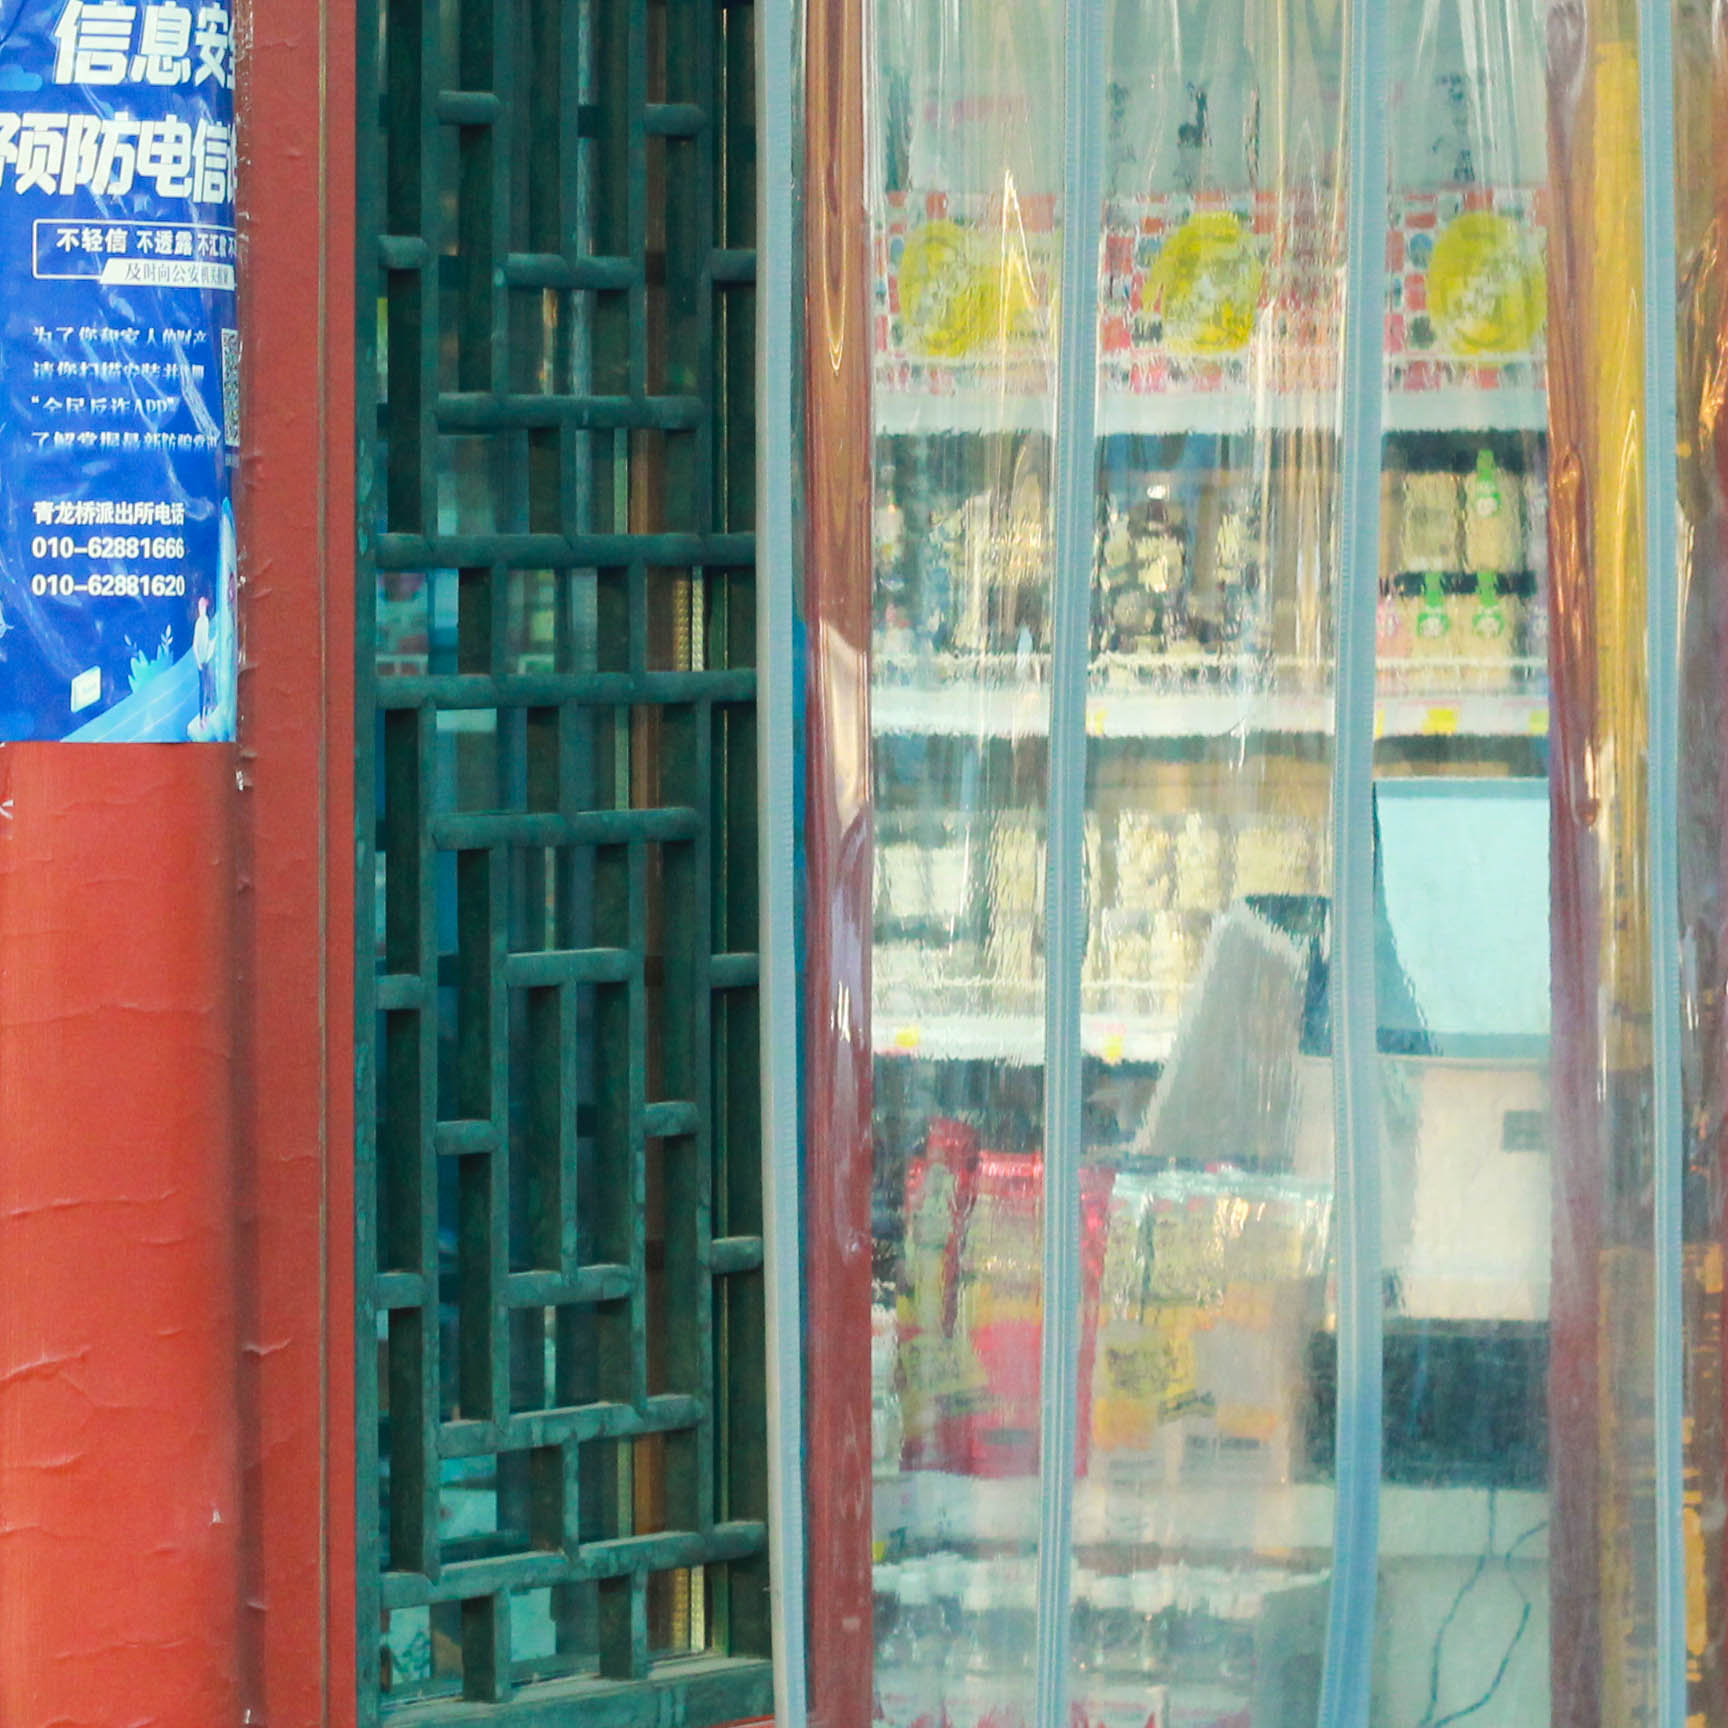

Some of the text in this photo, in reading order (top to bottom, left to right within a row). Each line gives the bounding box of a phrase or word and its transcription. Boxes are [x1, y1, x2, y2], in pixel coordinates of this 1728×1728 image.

[56, 227, 128, 254] 不轻信
[136, 229, 193, 256] 不透露
[32, 500, 184, 526] 青龙桥派出所电话
[32, 537, 185, 559] 010-62881666
[32, 575, 185, 596] 010-62881620
